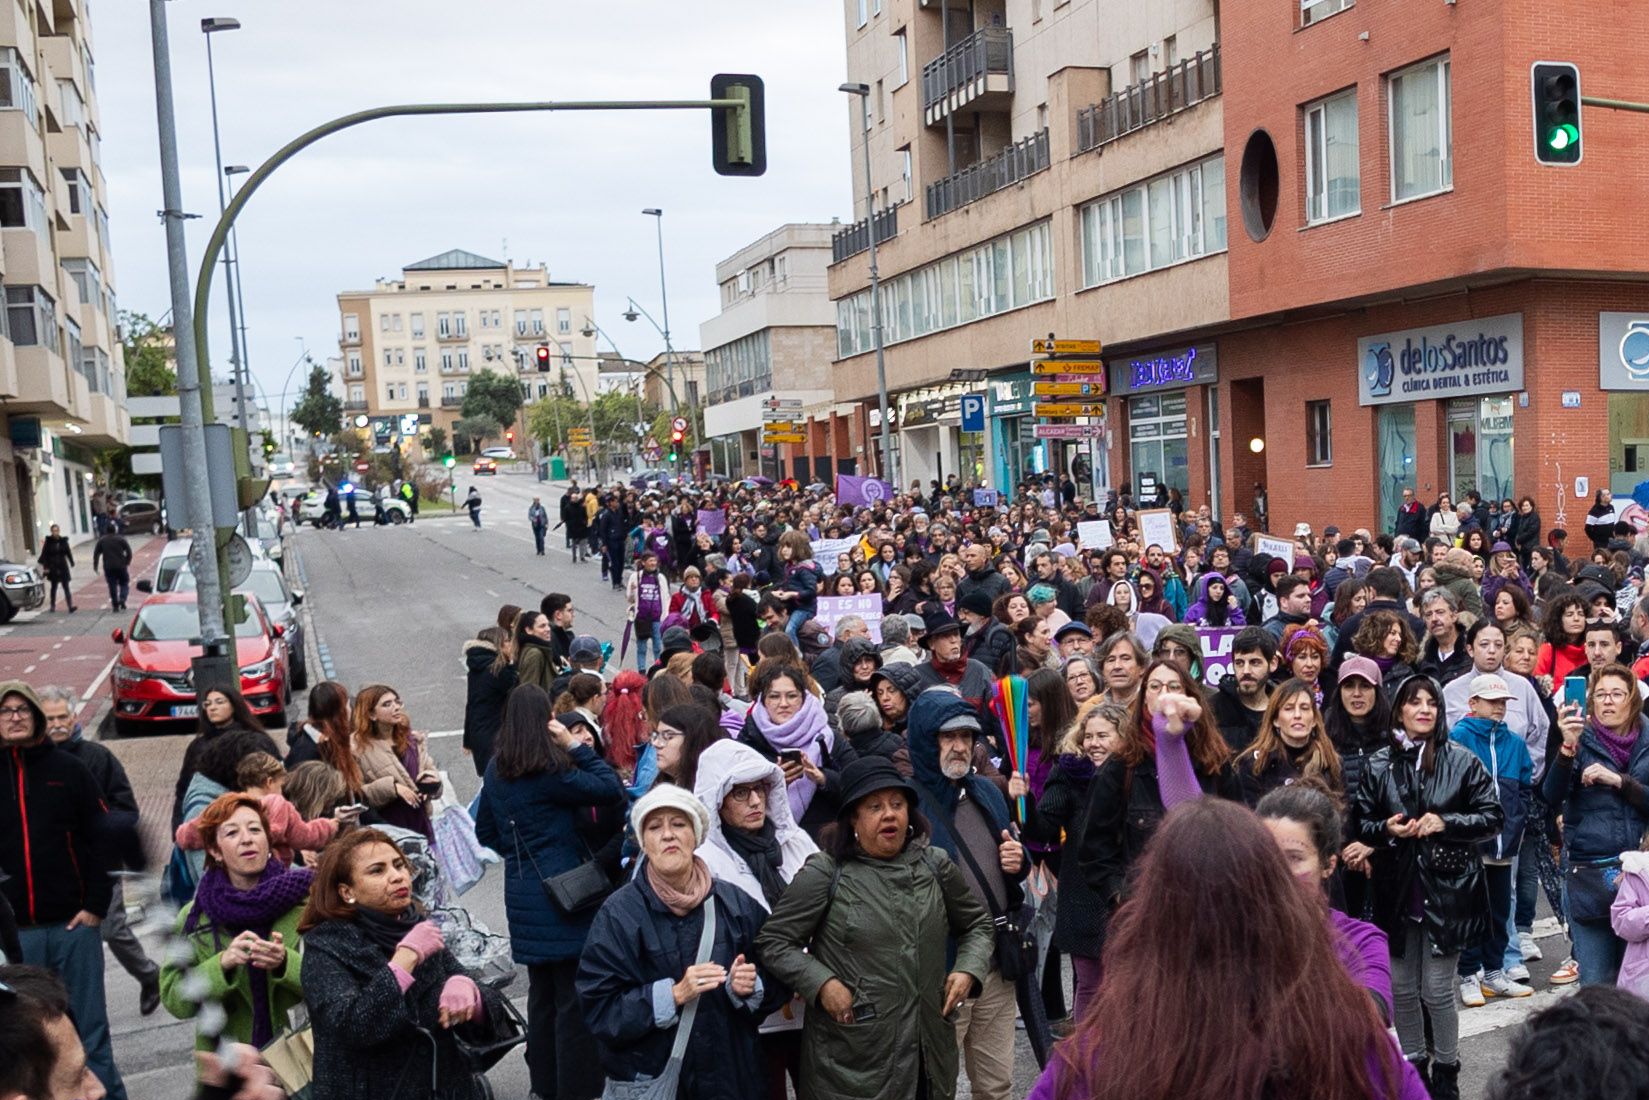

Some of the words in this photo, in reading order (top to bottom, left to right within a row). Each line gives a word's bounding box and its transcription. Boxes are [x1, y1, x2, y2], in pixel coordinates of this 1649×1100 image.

[1400, 332, 1509, 376] delosSantos
[1402, 377, 1432, 393] CLÍNICA
[1432, 374, 1461, 389] DENTAL
[1464, 374, 1471, 387] &
[1472, 368, 1511, 386] ESTÉTICA
[964, 399, 980, 419] P
